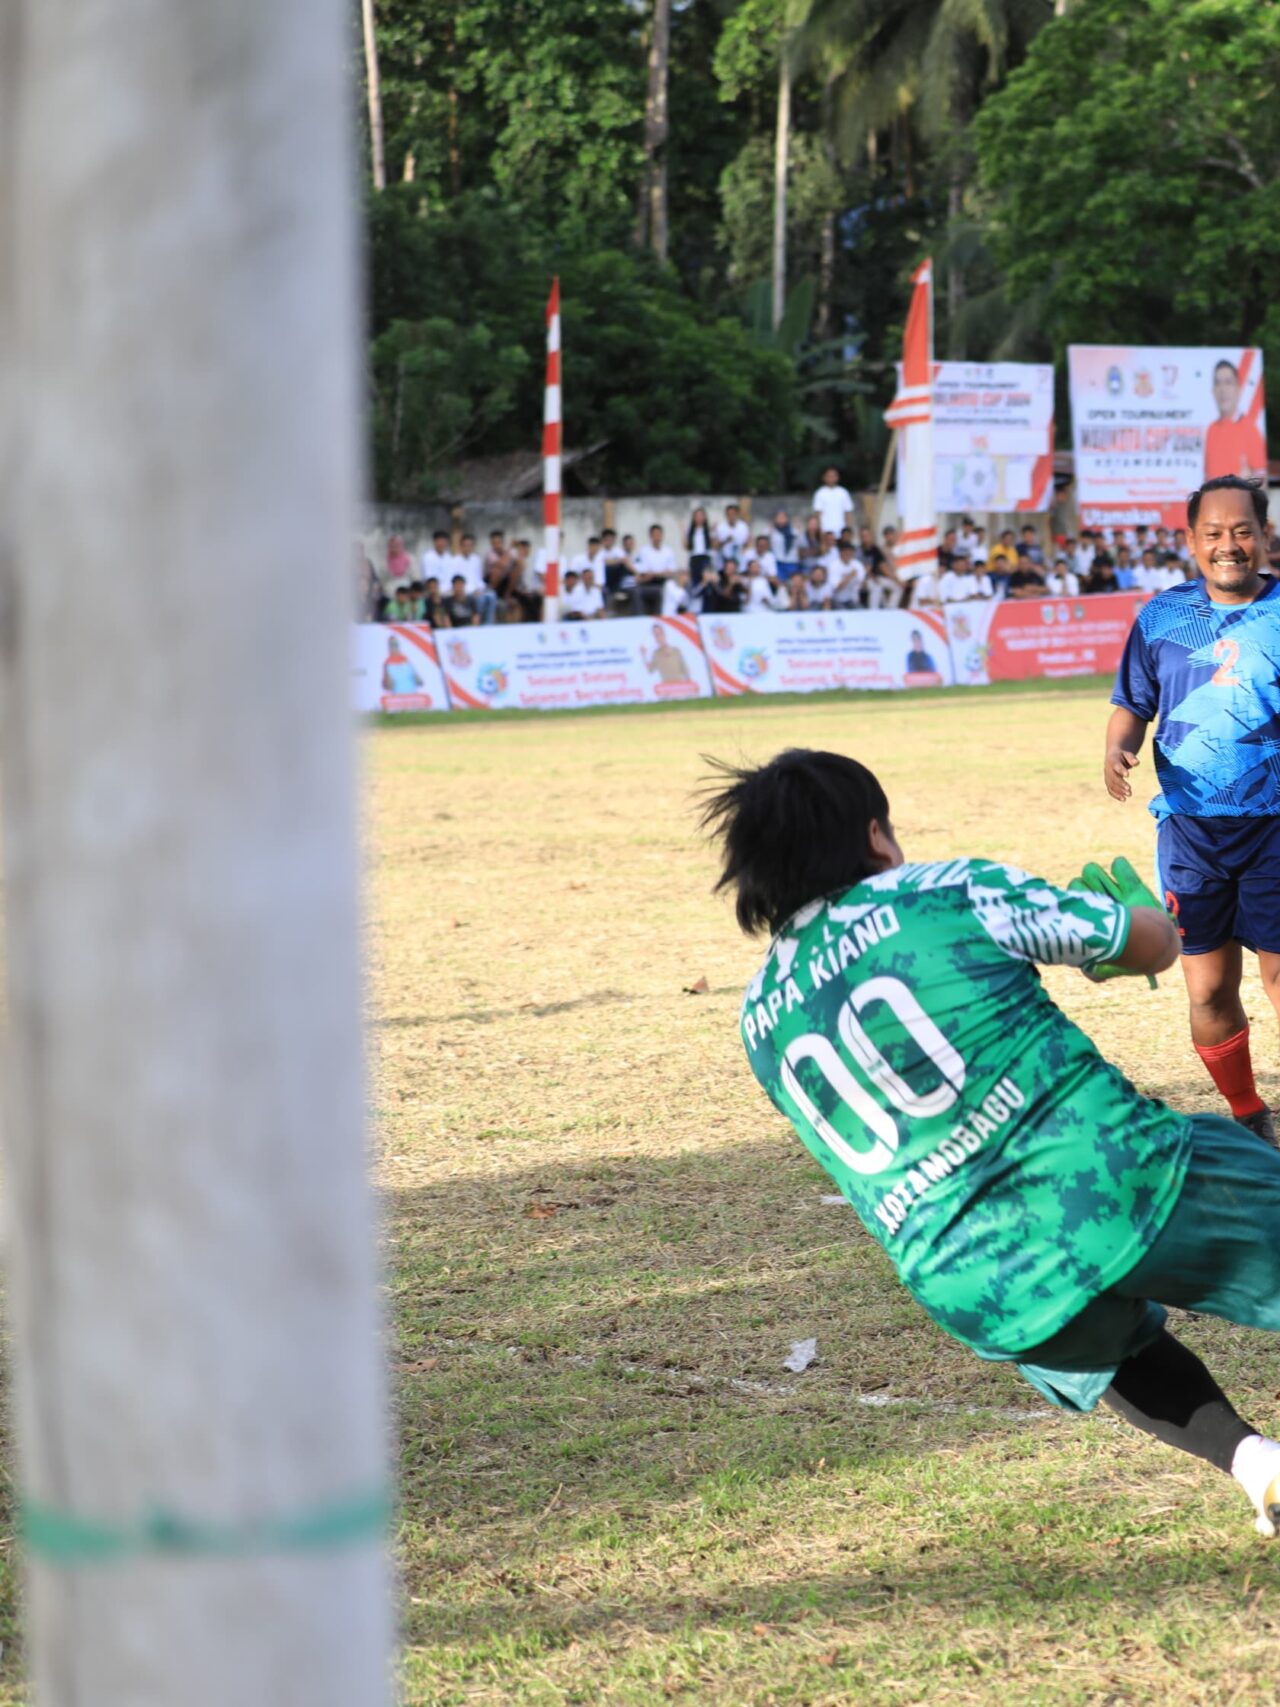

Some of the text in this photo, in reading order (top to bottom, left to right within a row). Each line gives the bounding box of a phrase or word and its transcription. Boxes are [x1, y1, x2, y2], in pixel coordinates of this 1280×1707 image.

[1212, 639, 1240, 686] 2
[808, 903, 901, 990] KIANO
[742, 982, 805, 1051] PAPA
[780, 975, 966, 1175] 00
